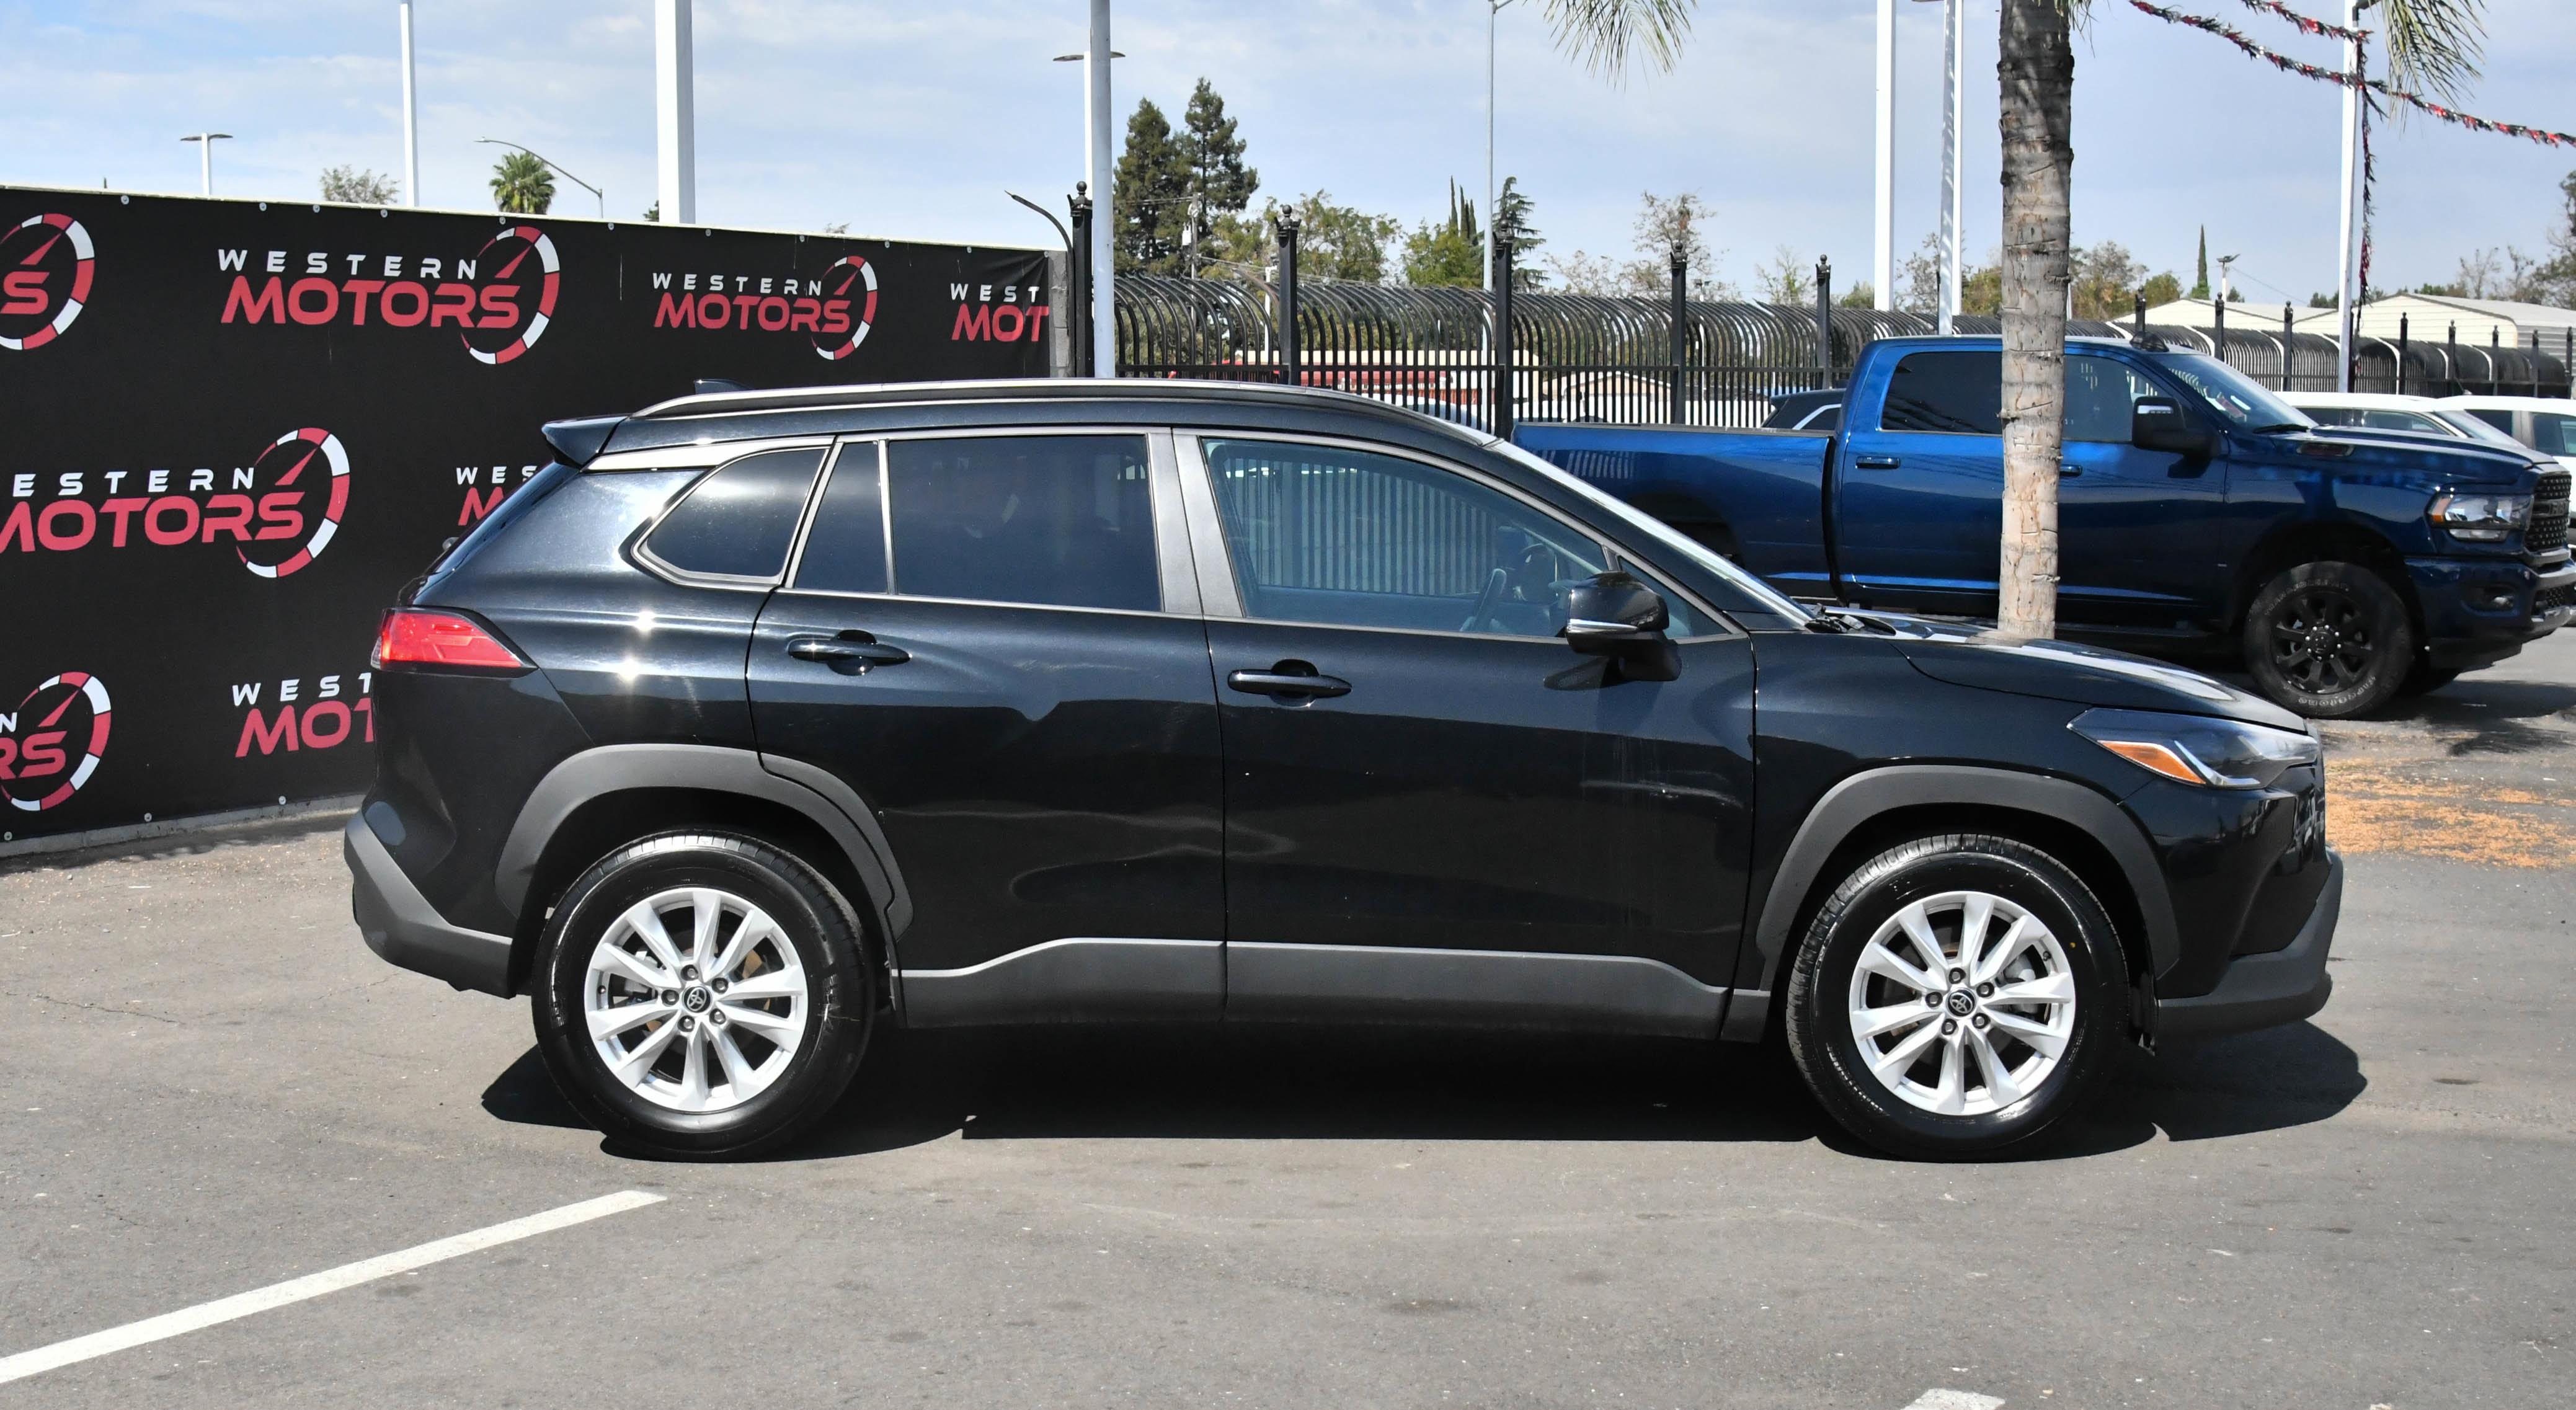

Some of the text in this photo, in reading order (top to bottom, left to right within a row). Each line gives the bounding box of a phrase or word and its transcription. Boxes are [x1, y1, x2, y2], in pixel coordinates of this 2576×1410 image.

[218, 249, 476, 280] WESTERN
[652, 272, 822, 296] WESTERN
[950, 283, 1040, 303] WEST
[221, 275, 520, 329] MOTORS
[654, 292, 851, 333] MOTORS
[952, 303, 1050, 342] MOT
[12, 467, 254, 497] ESTERN
[232, 672, 371, 707] WEST
